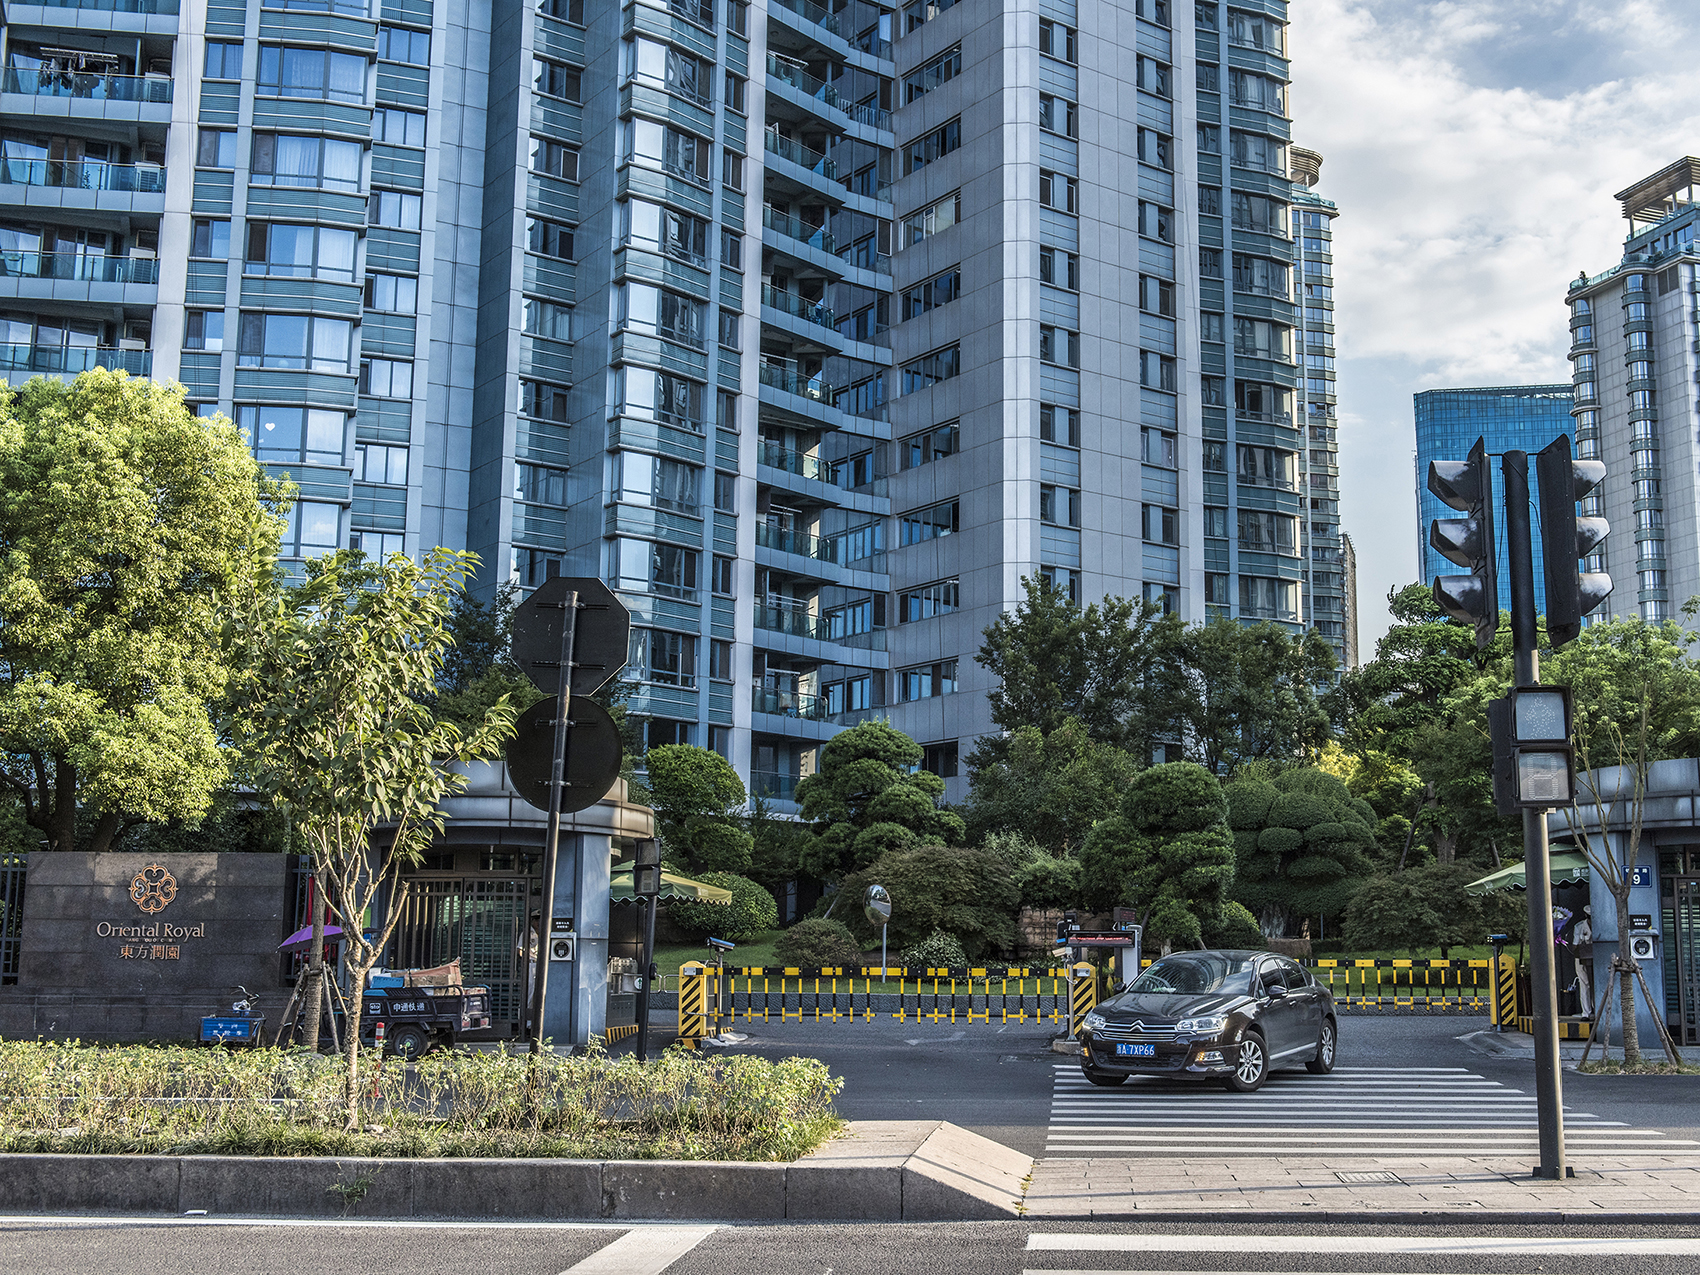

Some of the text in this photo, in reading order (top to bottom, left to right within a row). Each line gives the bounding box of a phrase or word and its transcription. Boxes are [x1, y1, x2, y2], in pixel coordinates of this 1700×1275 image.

[1632, 874, 1641, 885] 9
[96, 921, 205, 943] Oriental Royal
